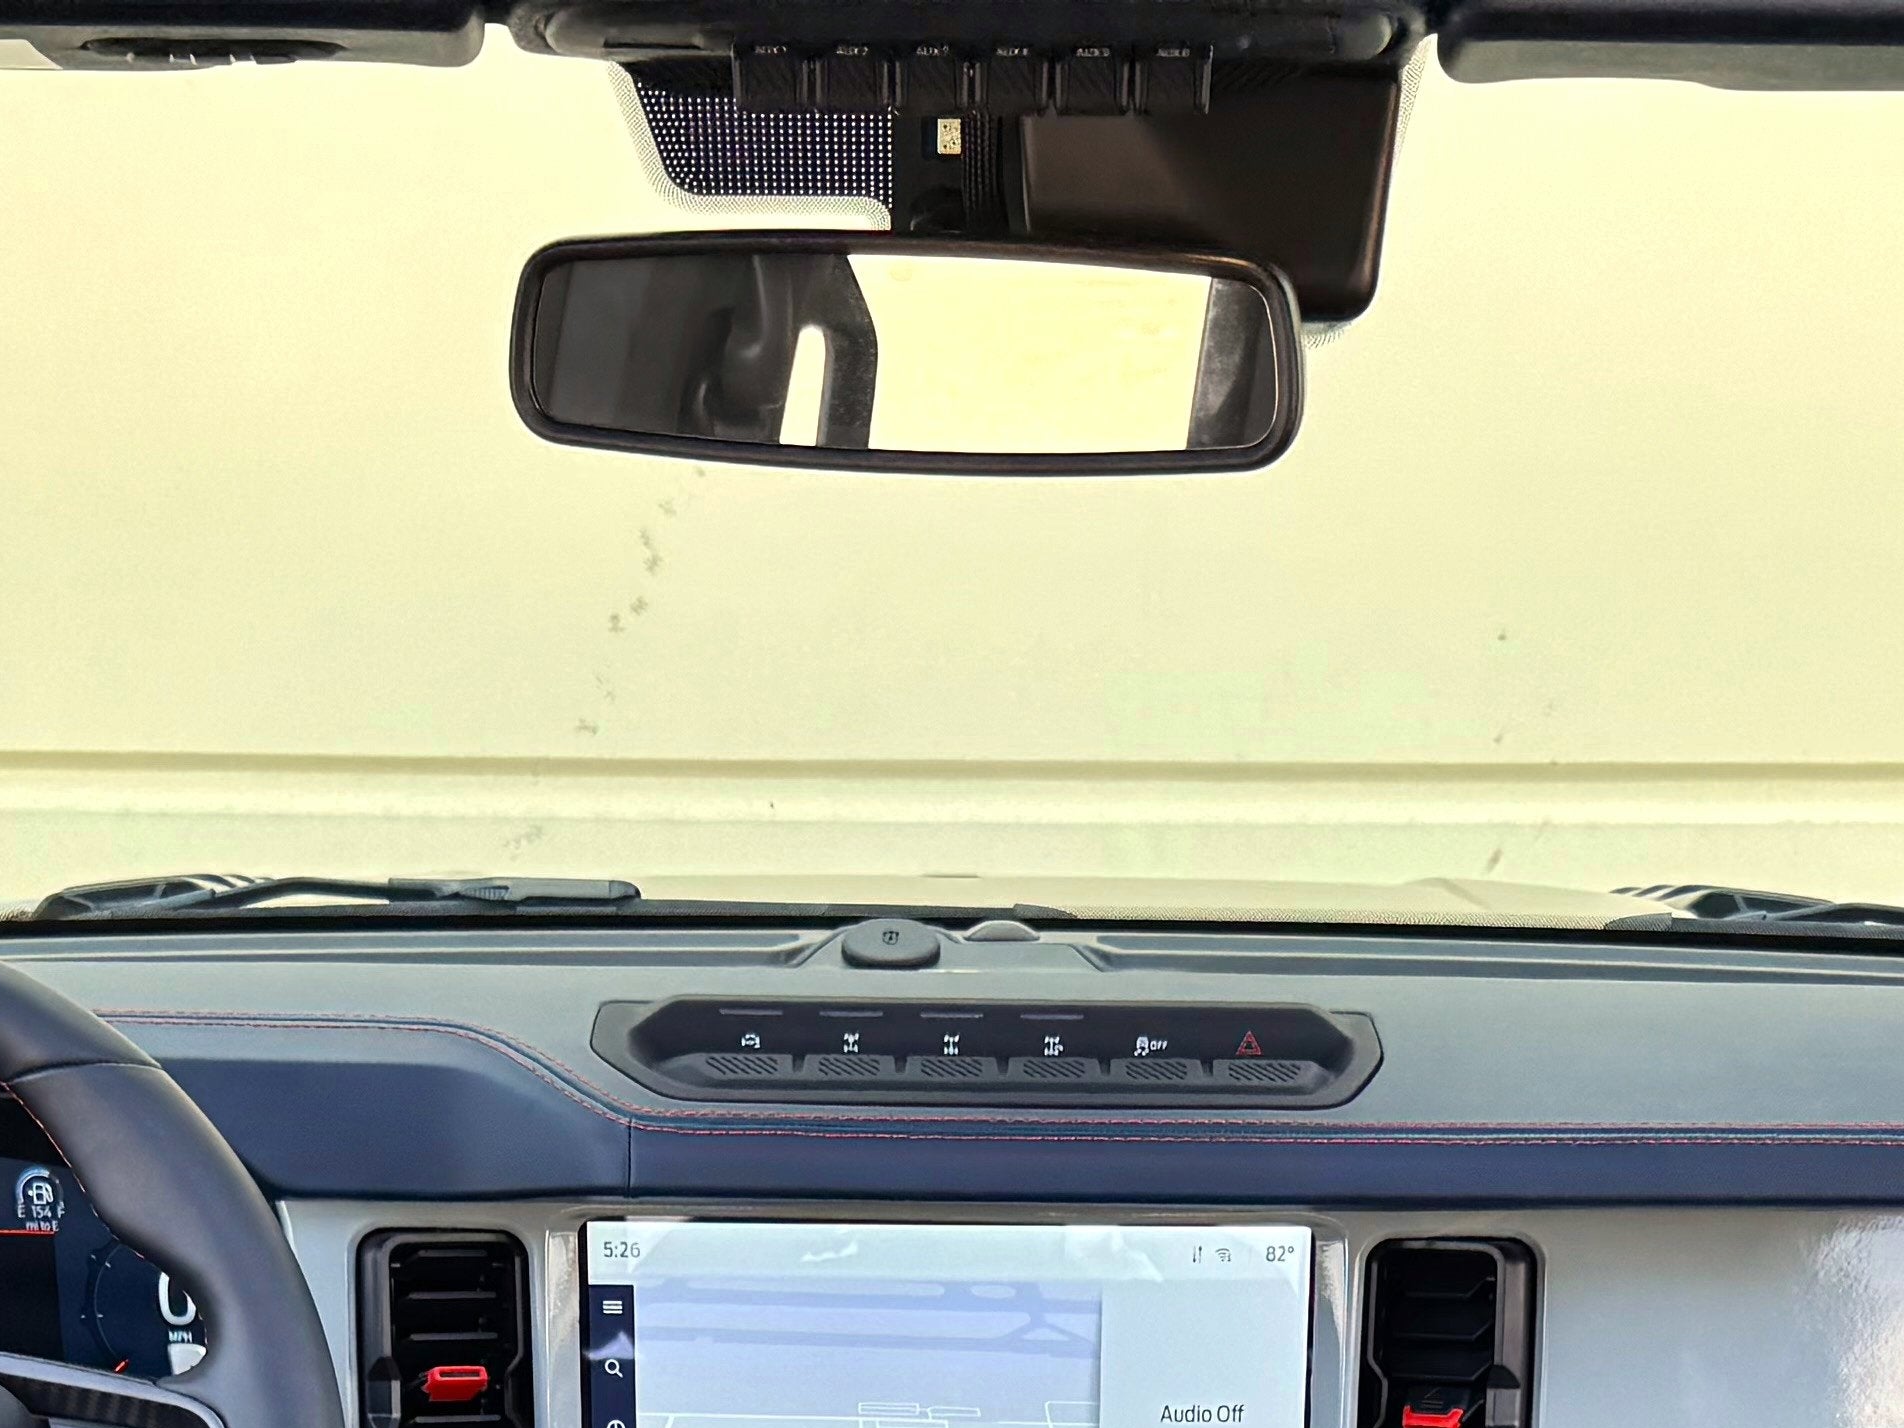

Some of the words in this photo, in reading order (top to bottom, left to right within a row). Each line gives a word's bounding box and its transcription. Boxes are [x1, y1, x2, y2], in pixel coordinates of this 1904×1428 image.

[31, 1204, 52, 1219] 154
[602, 1241, 641, 1258] 5:26
[1265, 1245, 1295, 1262] 82°
[1160, 1405, 1212, 1423] Audio
[1217, 1405, 1245, 1423] Off
